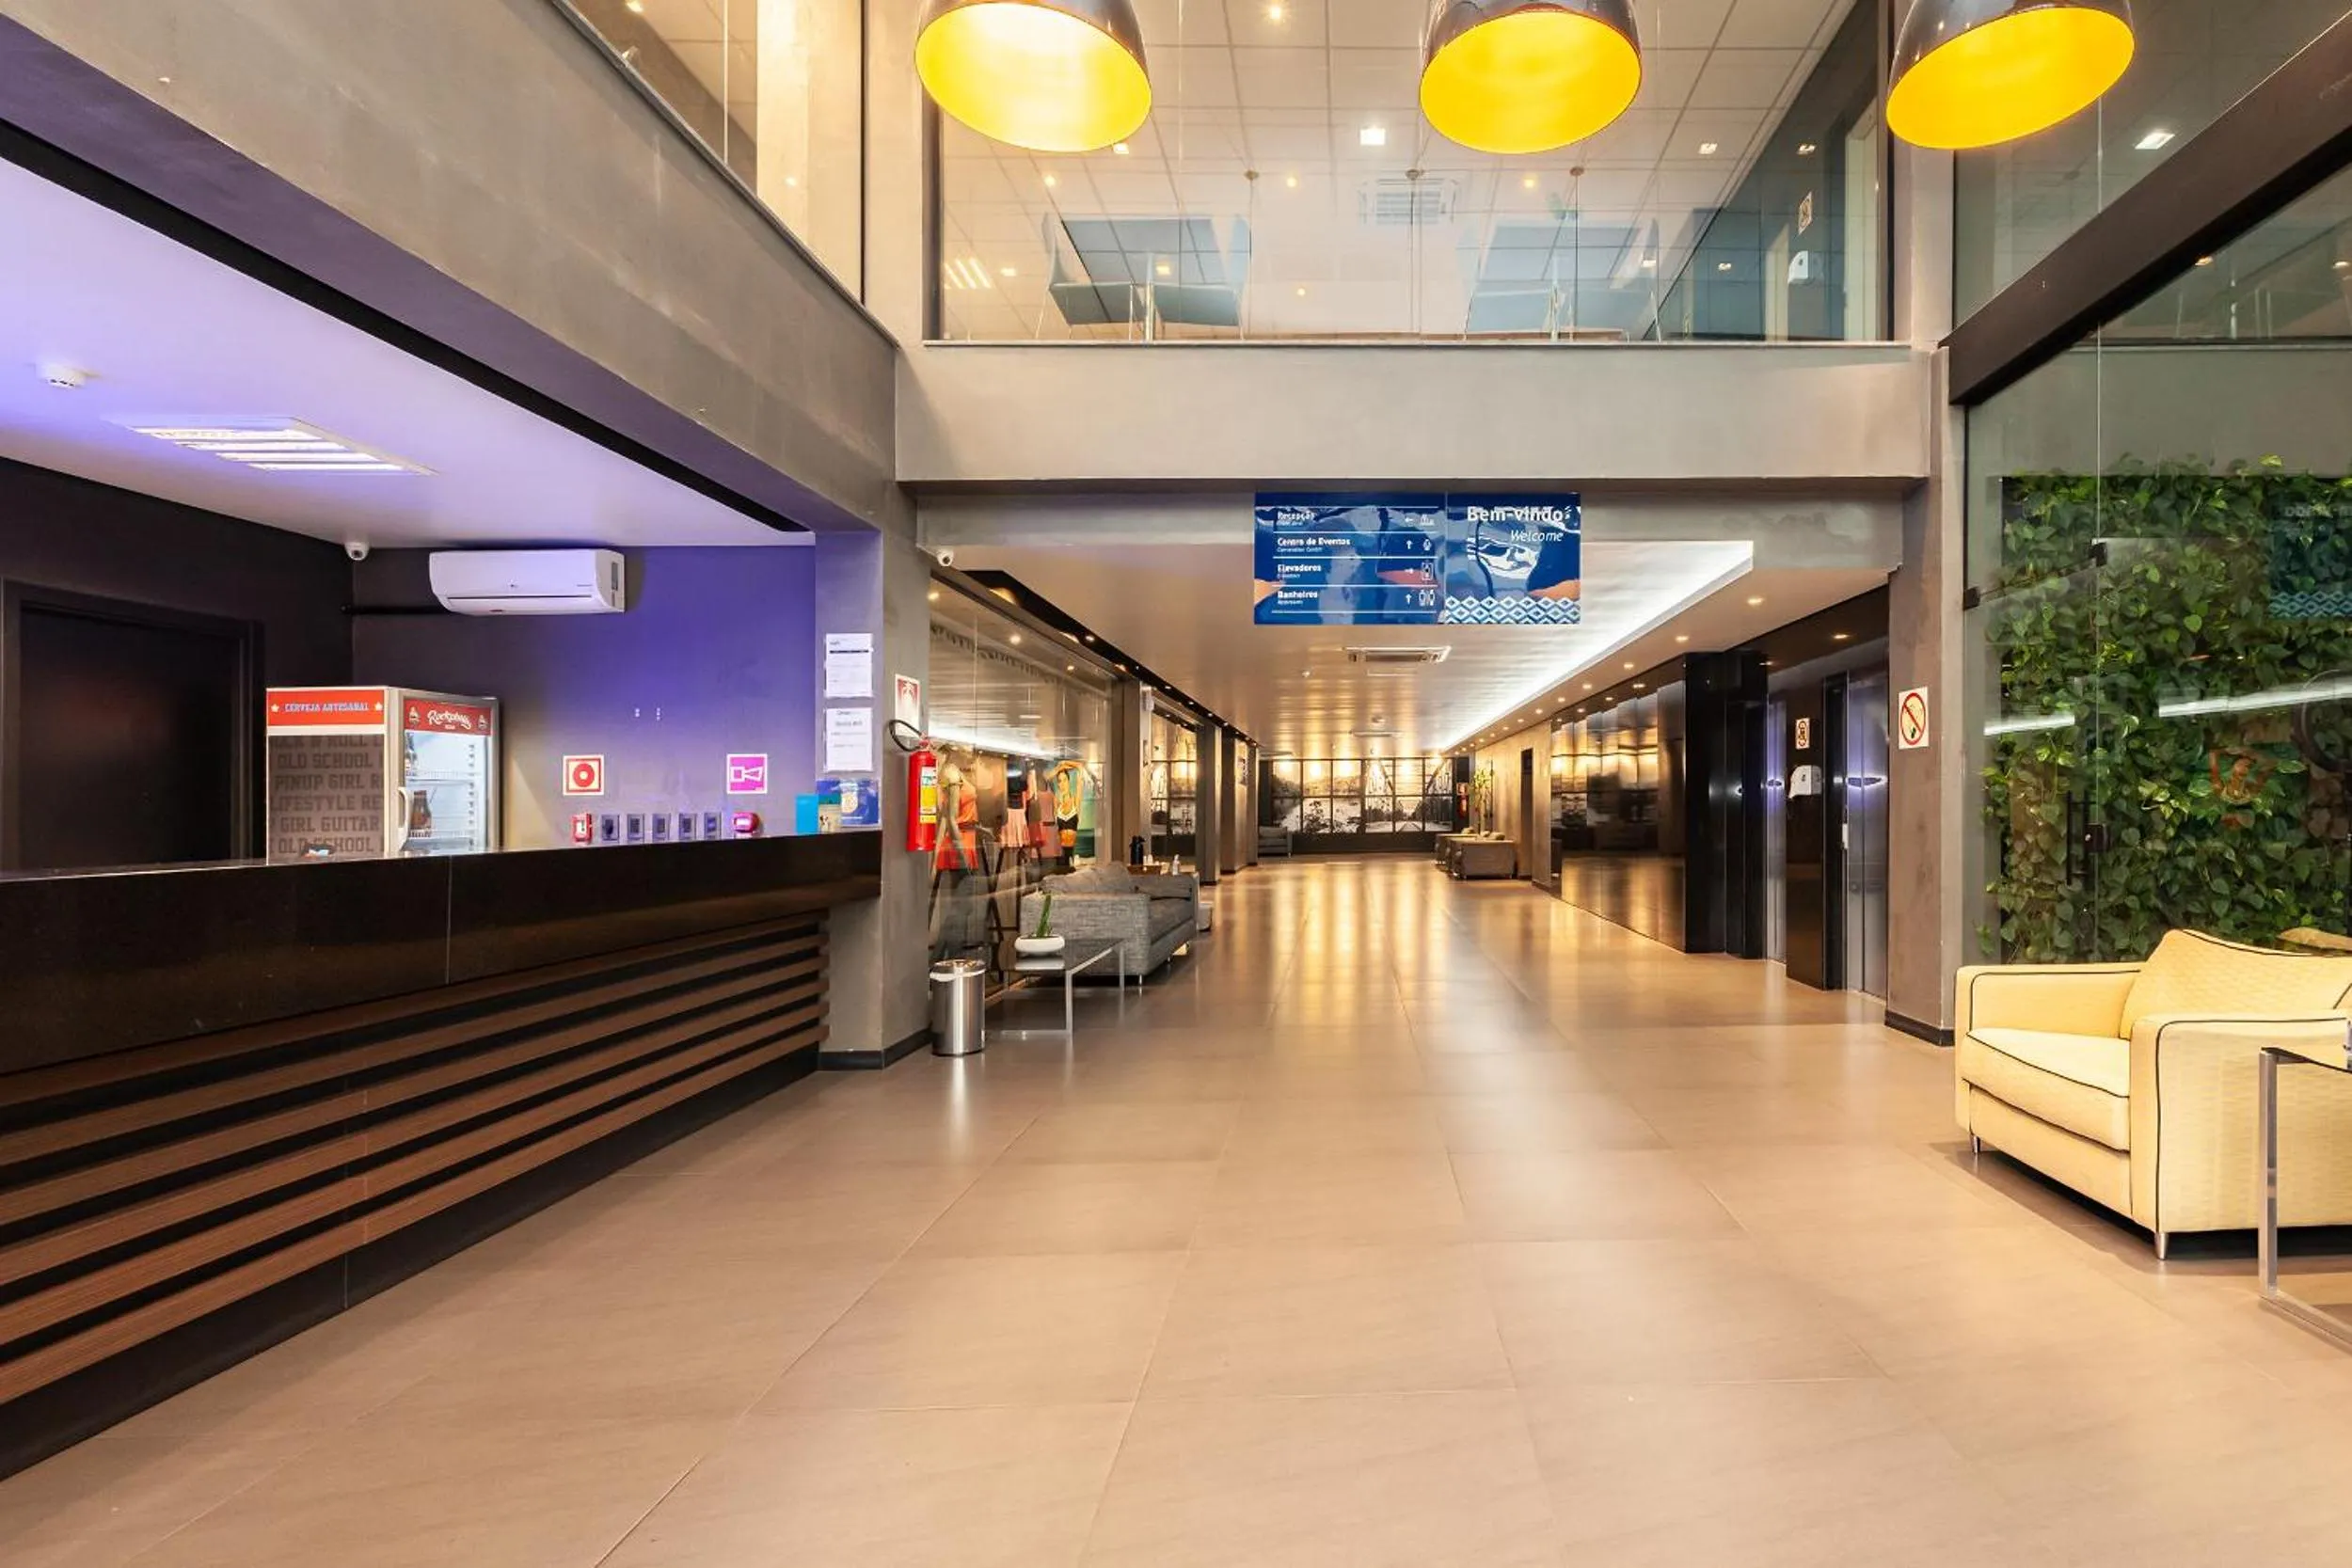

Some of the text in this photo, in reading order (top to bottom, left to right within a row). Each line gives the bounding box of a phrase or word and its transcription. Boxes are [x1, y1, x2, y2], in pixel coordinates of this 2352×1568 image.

[1467, 505, 1564, 522] Bem-vindo
[1277, 537, 1351, 546] Centro de Eventos
[1510, 530, 1564, 542] Welcome
[1277, 563, 1322, 573] Elevadores
[278, 752, 373, 769] OLD SCHOOL
[328, 772, 365, 790] GIRL
[280, 816, 316, 833] GIRL
[321, 815, 380, 832] GUITAR
